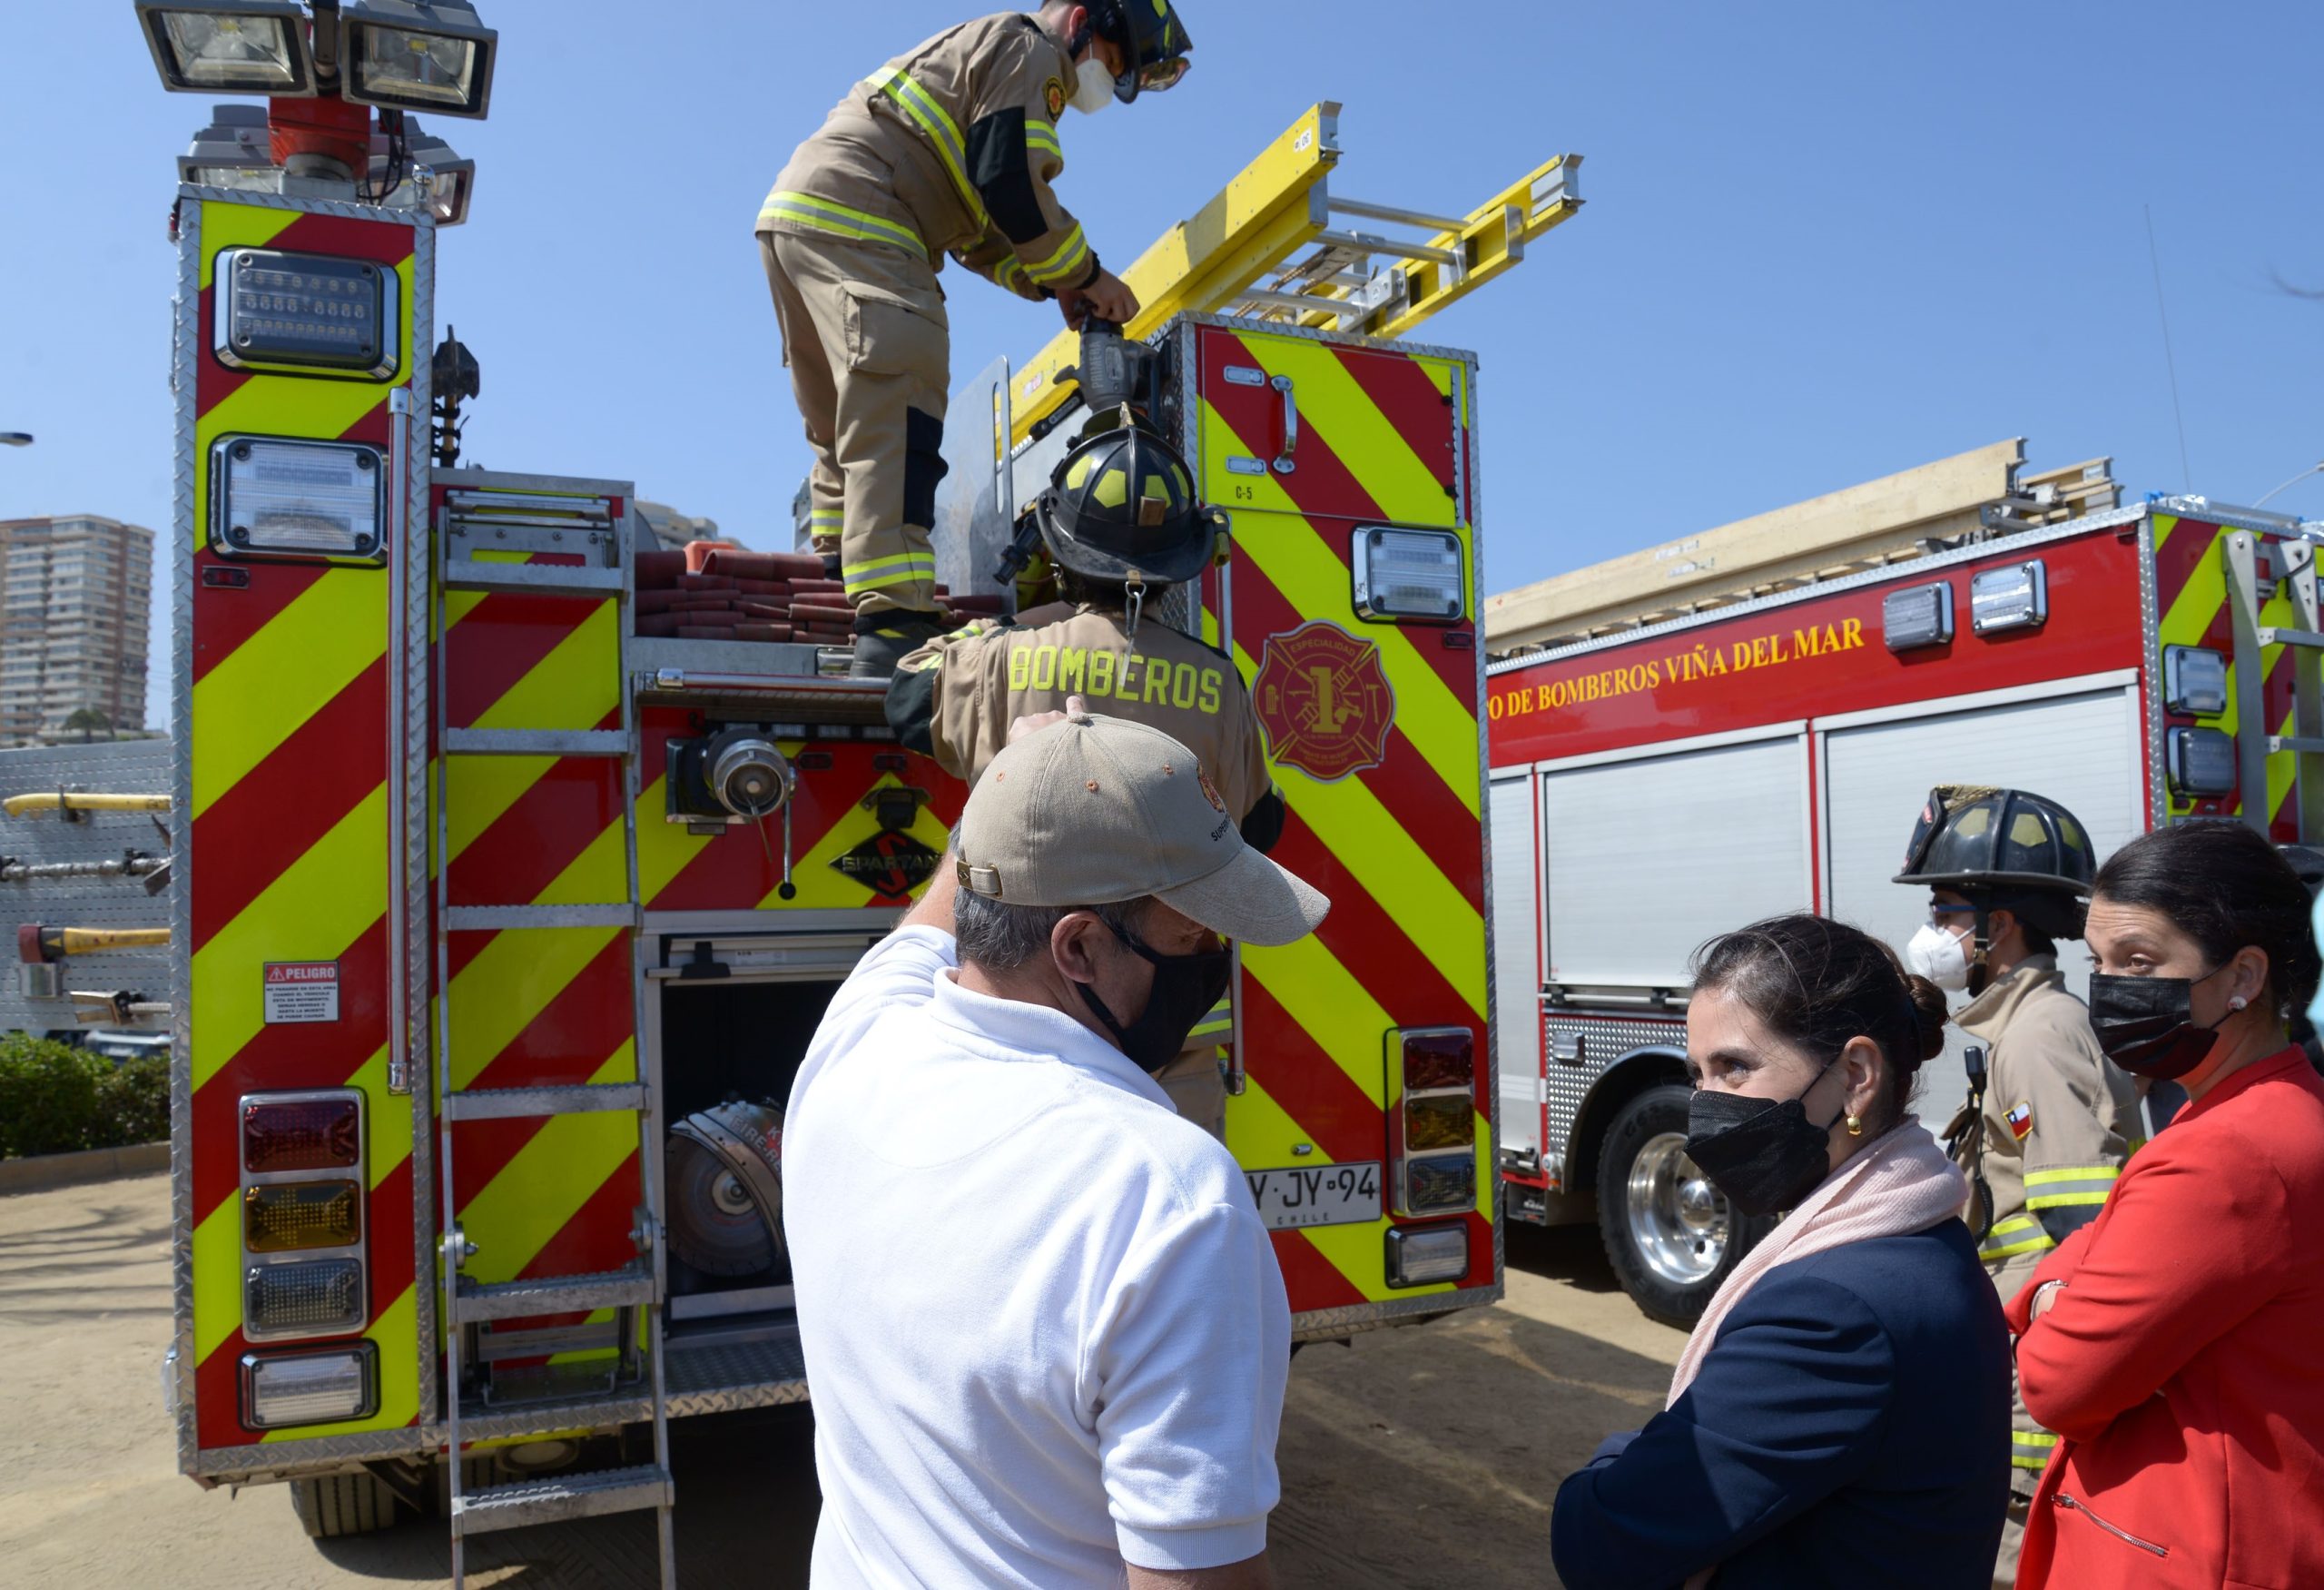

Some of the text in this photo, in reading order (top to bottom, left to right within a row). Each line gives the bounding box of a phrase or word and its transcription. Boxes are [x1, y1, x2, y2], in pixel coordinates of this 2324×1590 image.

[1089, 341, 1104, 390] PRIMERA
[1236, 486, 1253, 500] C-5
[1289, 638, 1356, 657] ESPECIALIDAD
[1507, 688, 1534, 717] DE
[1538, 661, 1659, 711] BOMBEROS
[1665, 643, 1728, 684] VIÑA
[1733, 634, 1788, 673] DEL
[1793, 617, 1865, 660] MAR
[1009, 646, 1222, 715] BOMBEROS
[285, 967, 335, 980] PELIGRO
[1276, 1212, 1329, 1225] CHILE
